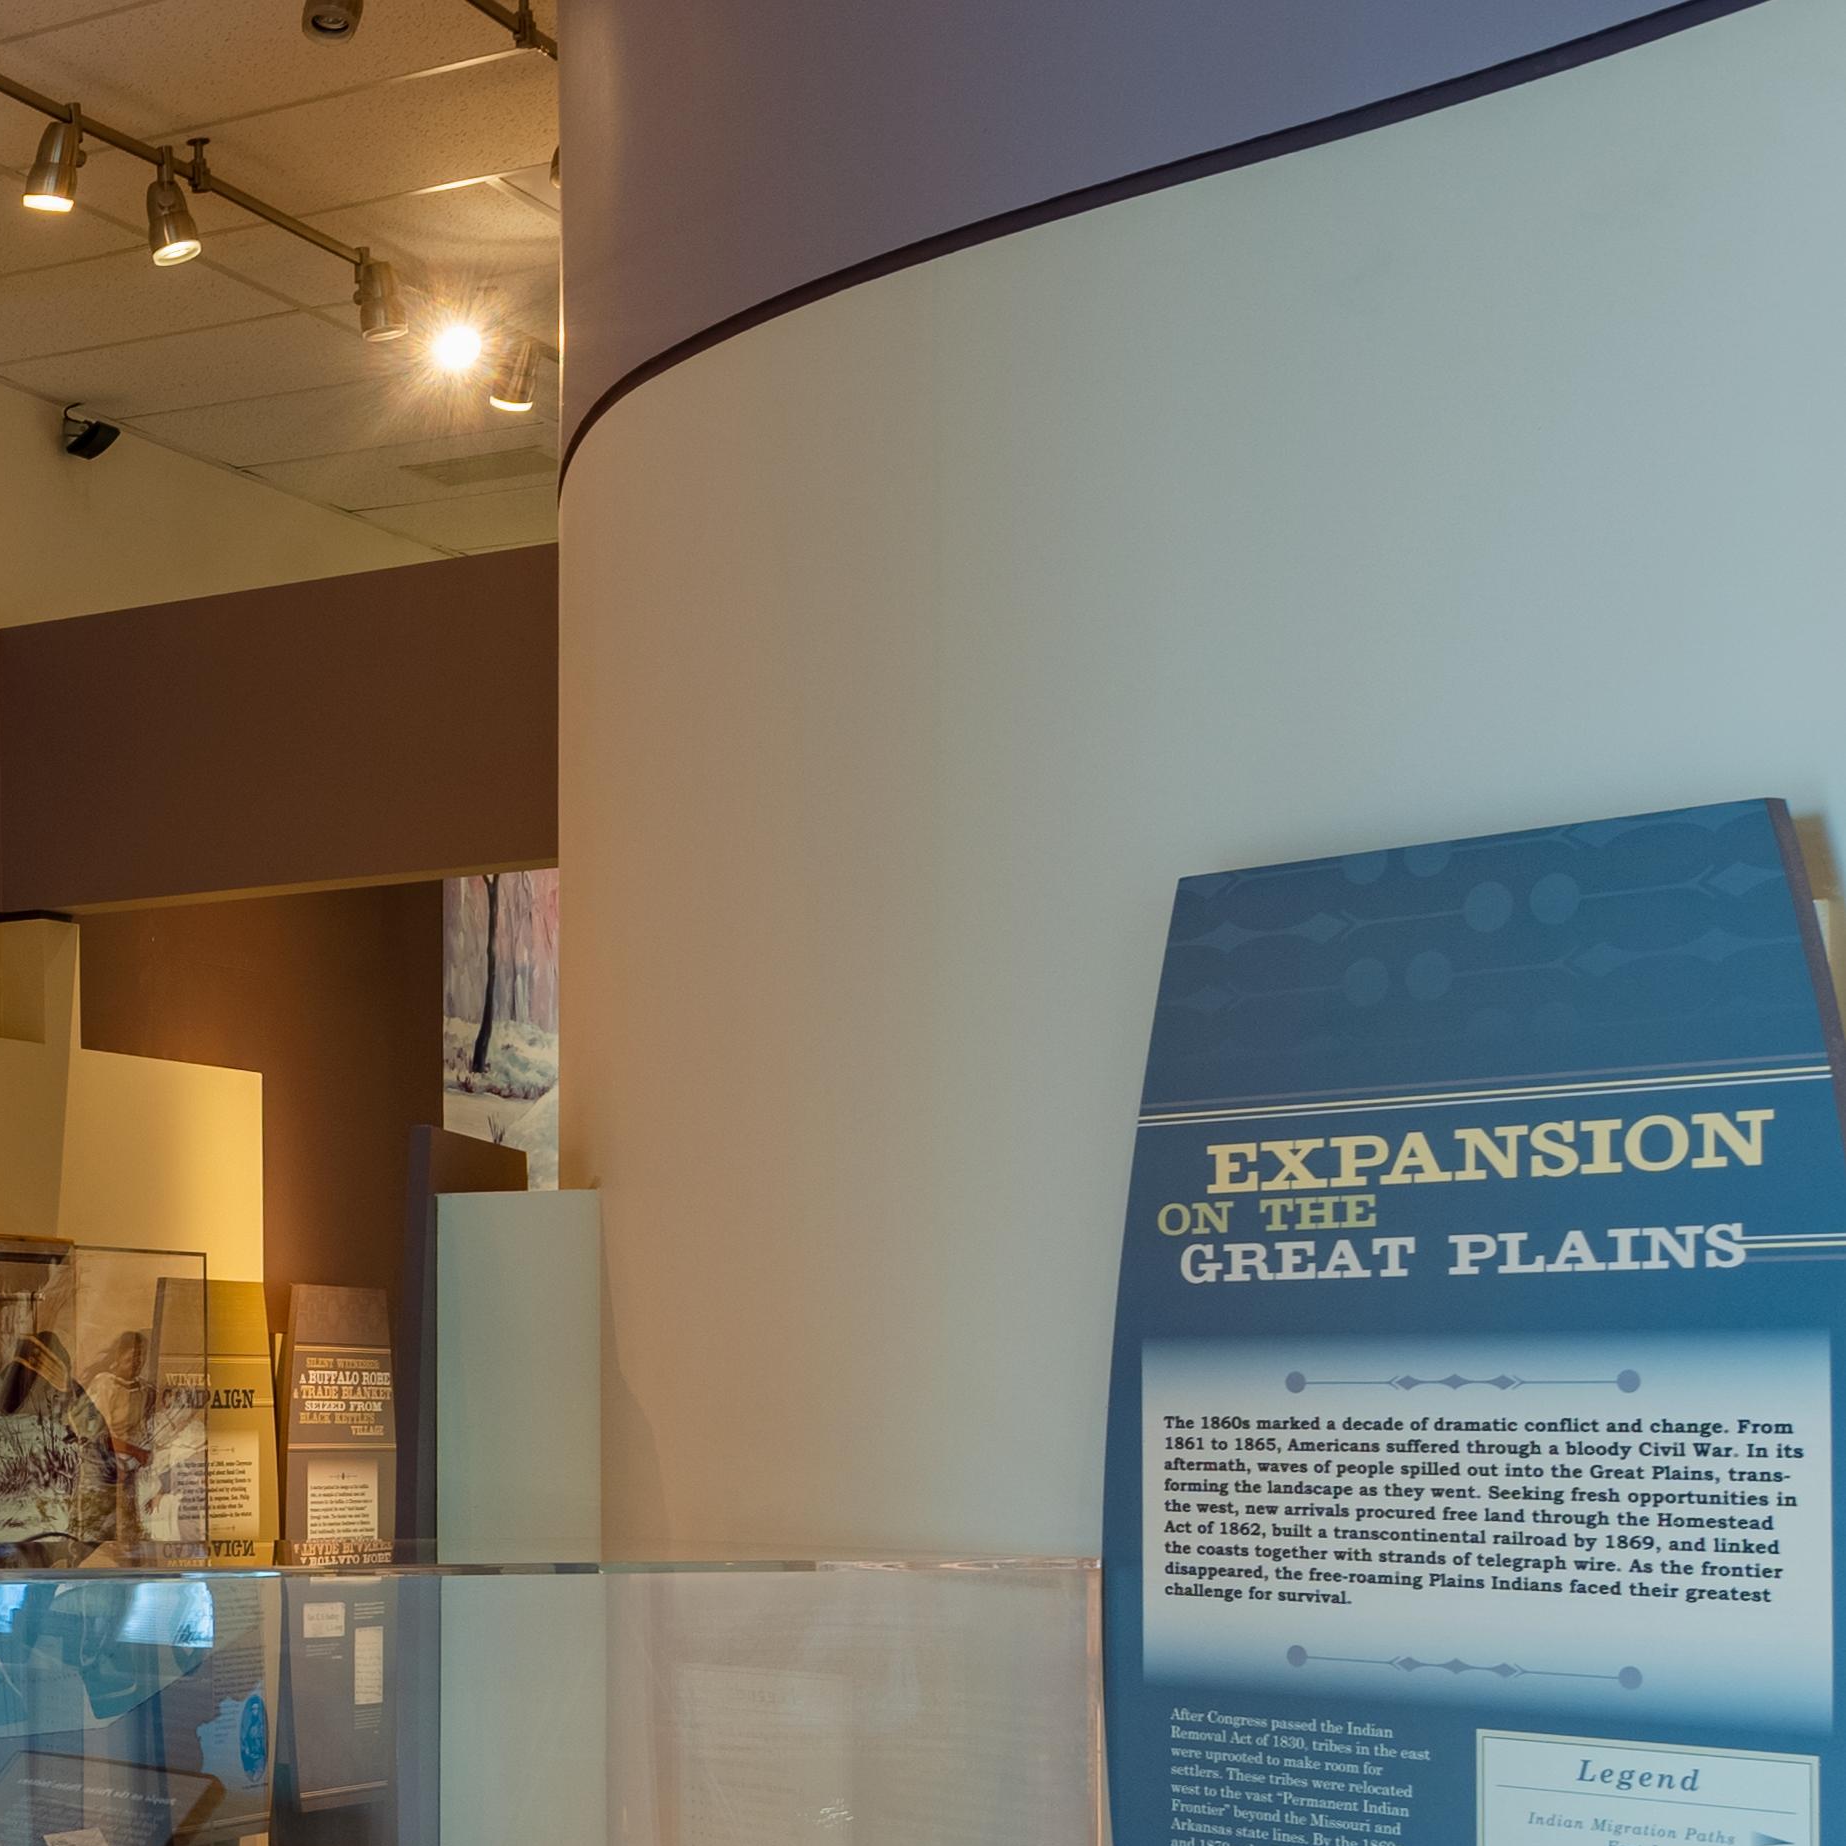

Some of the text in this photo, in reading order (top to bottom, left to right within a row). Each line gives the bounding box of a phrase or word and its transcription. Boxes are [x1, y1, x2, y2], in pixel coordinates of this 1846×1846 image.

[1207, 1109, 1774, 1194] EXPANSION
[1157, 1194, 1376, 1236] ON THE
[1180, 1223, 1745, 1284] GREAT PLAINS
[165, 1373, 211, 1386] WINTER
[308, 1370, 360, 1385] BUFFALO
[361, 1371, 391, 1386] ROBE
[301, 1385, 393, 1400] TRADE BLANKET
[299, 1412, 332, 1424] BLACK
[305, 1401, 383, 1412] SEIZED FROM
[350, 1425, 384, 1436] VILLAGE
[1162, 1414, 1794, 1439] The 1860s marked a decade of dramatic conflict and change. From
[1169, 1706, 1394, 1739] After Congress passed the Indian
[1576, 1759, 1700, 1792] Legend
[1527, 1810, 1736, 1846] Indian Migration Paths
